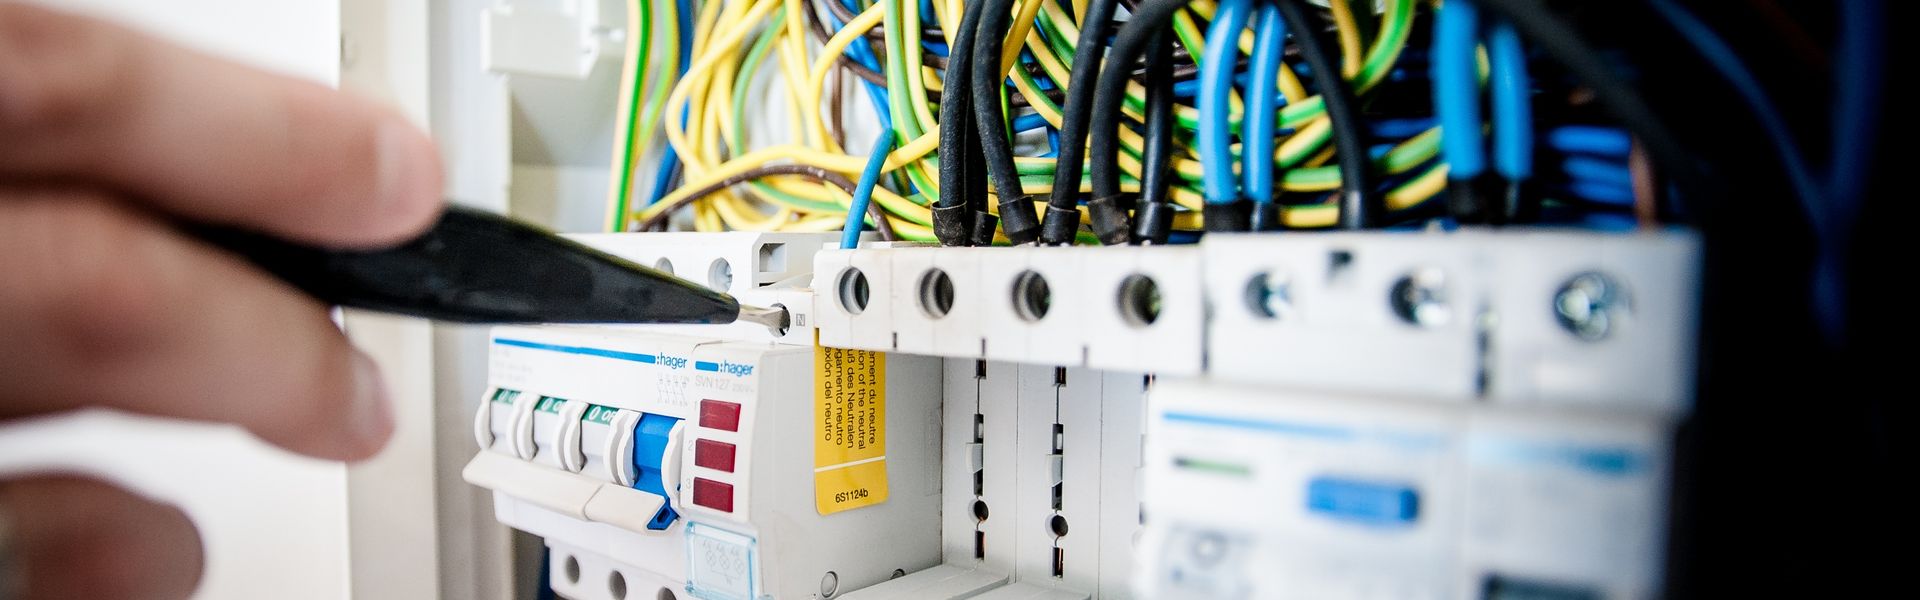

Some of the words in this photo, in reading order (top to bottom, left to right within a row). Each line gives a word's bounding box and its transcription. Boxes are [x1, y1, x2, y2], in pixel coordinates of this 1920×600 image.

[847, 367, 855, 389] des
[858, 374, 866, 385] of
[825, 381, 833, 399] del
[858, 388, 866, 407] the
[869, 389, 876, 404] du
[847, 392, 855, 449] Neutralen
[858, 410, 866, 450] neutral
[868, 407, 876, 444] neutre
[835, 488, 869, 503] 6S1124b
